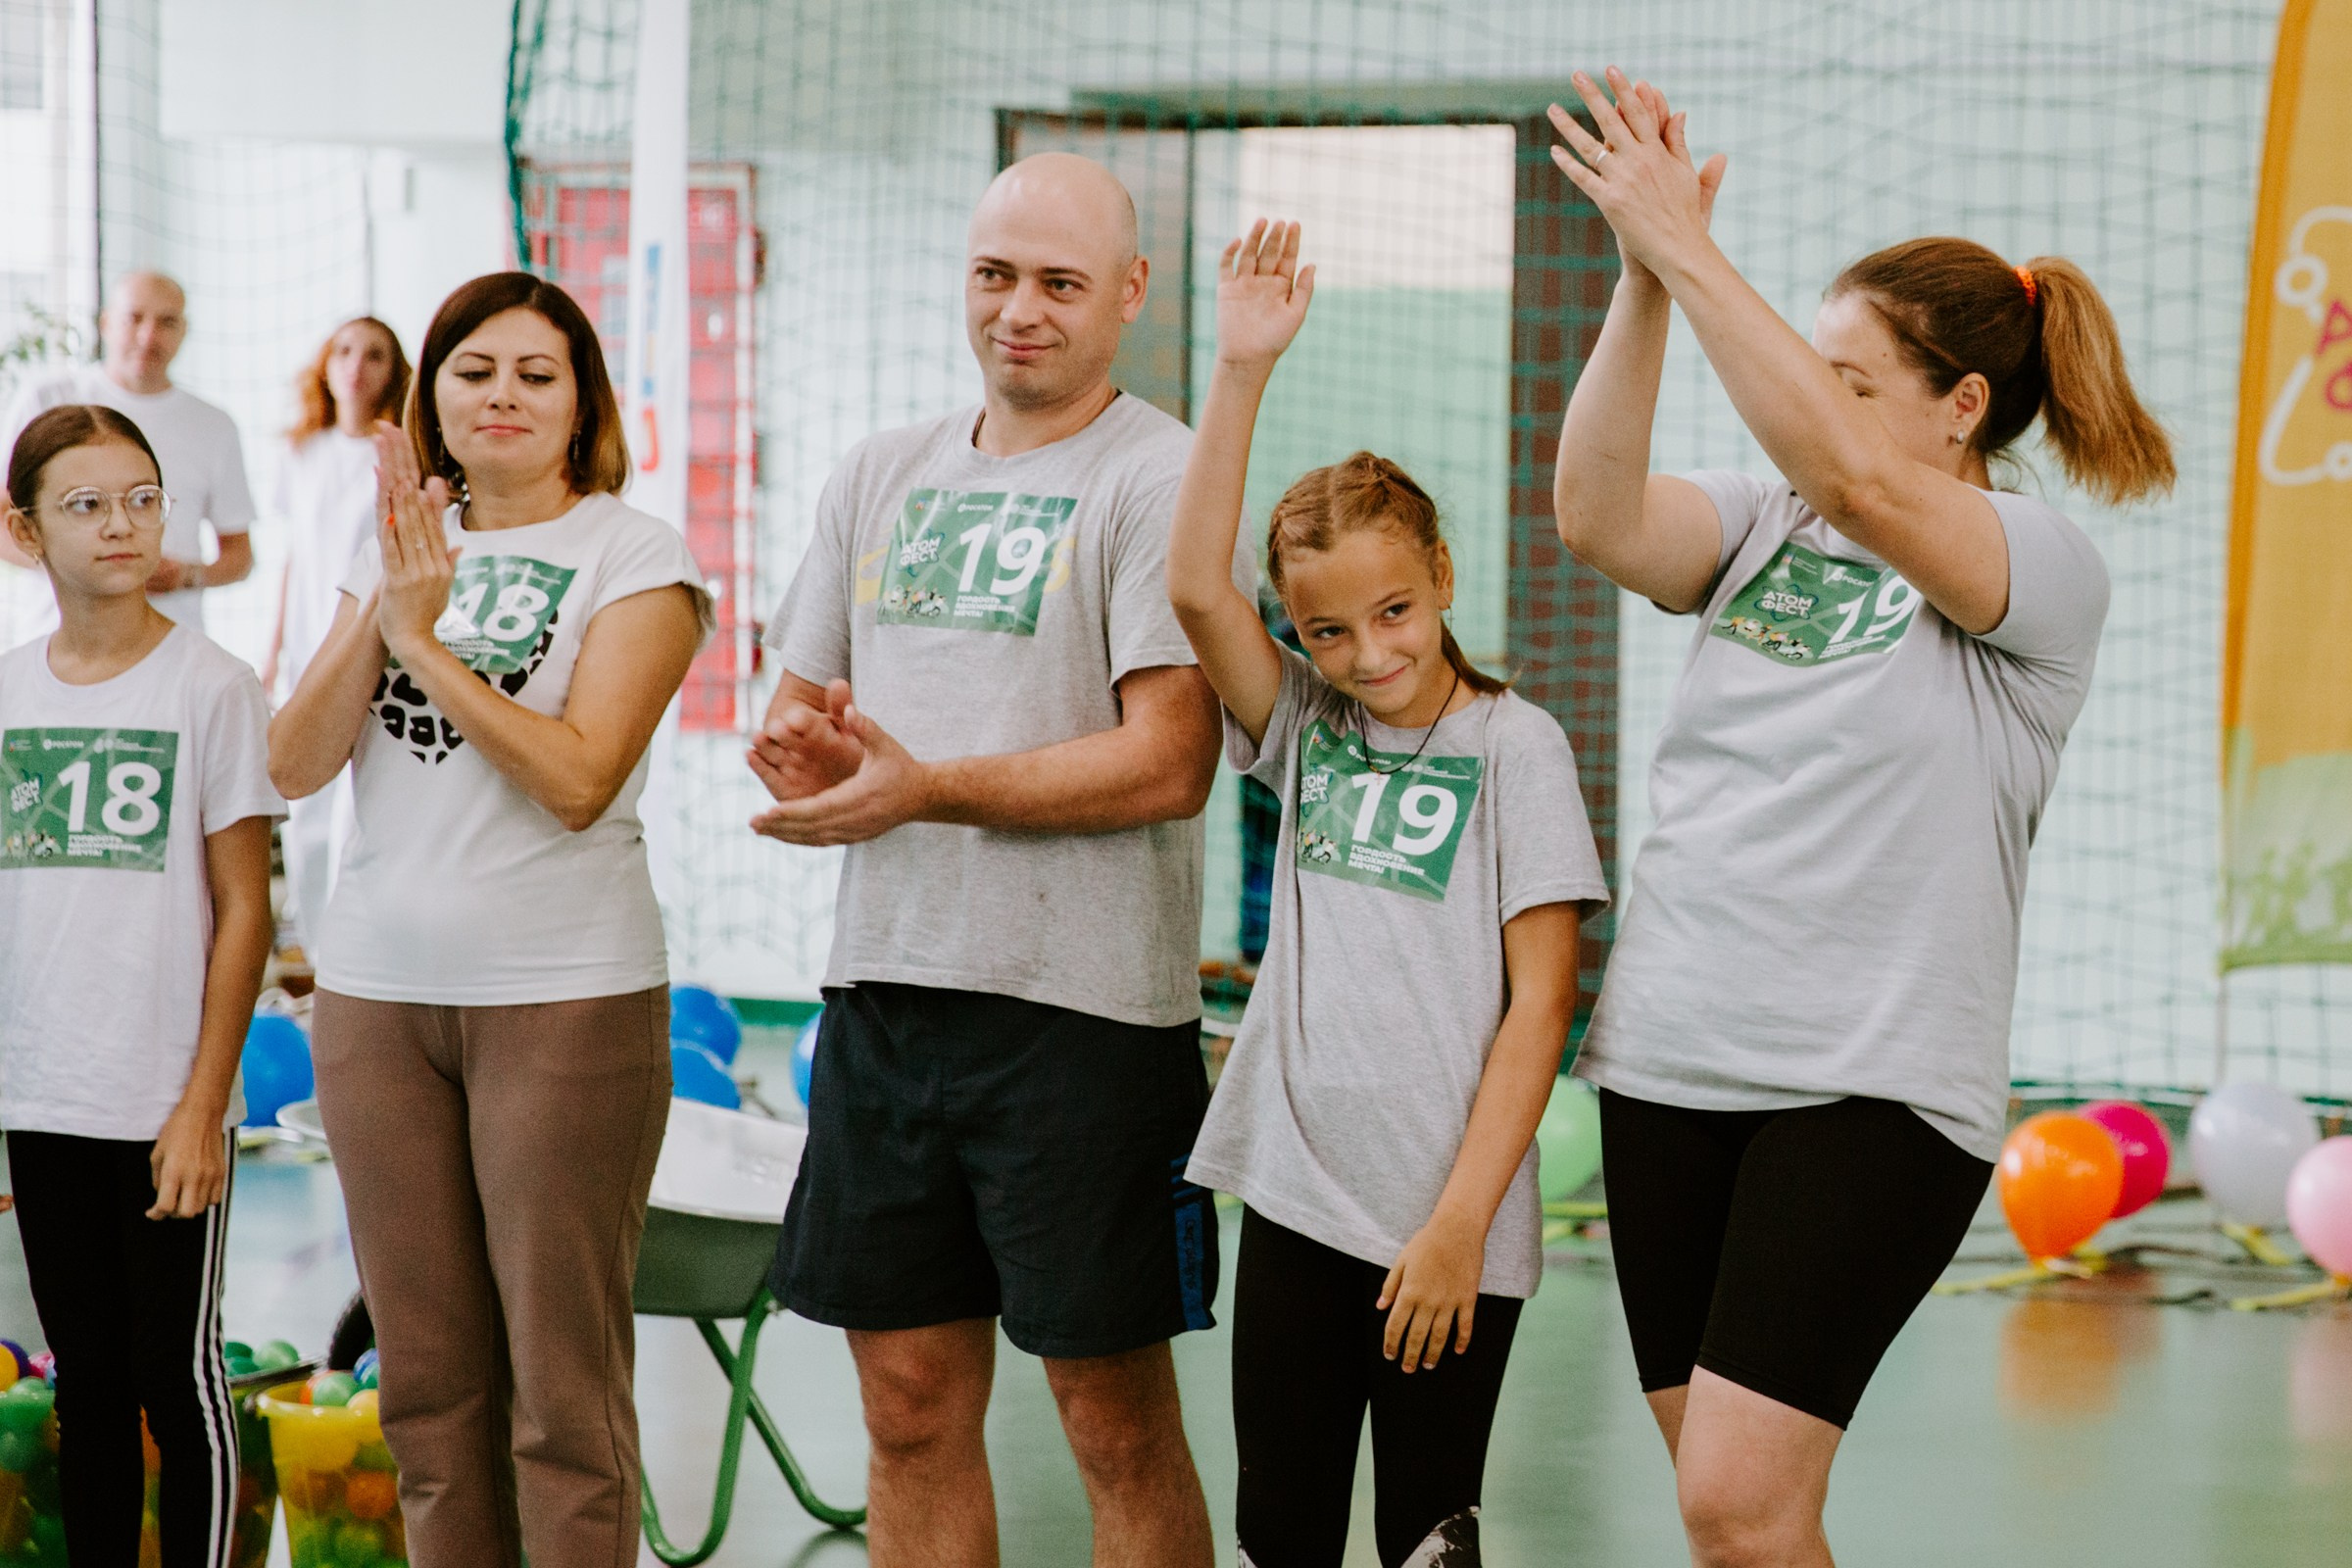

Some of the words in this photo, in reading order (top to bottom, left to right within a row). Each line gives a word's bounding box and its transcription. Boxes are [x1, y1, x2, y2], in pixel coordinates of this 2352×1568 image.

[902, 537, 941, 557] АТОМ
[900, 550, 938, 566] ФЕСТ
[957, 523, 1046, 596] 19
[1761, 599, 1810, 617] ФЕСТ
[1762, 590, 1813, 609] АТОМ
[1837, 573, 1924, 644] 19
[57, 760, 162, 837] 18
[1351, 772, 1458, 857] 19
[1351, 844, 1407, 863] ГОРДОСТЬ
[1348, 852, 1426, 877] ВДОХНОВЕНИЕ
[1348, 858, 1386, 874] МЕЧТА!
